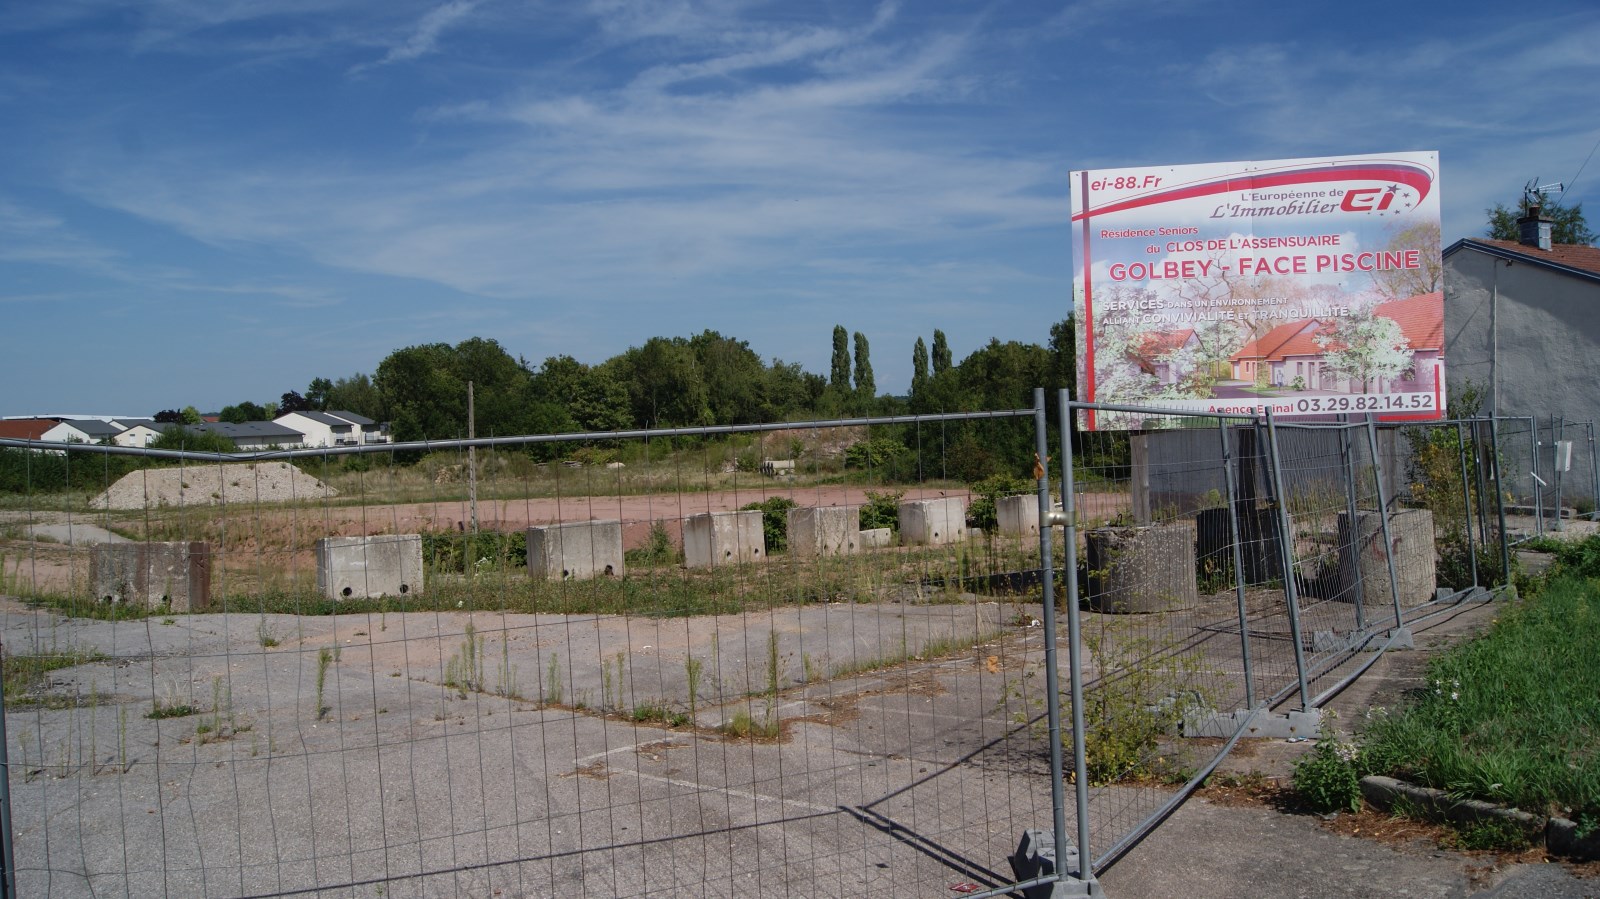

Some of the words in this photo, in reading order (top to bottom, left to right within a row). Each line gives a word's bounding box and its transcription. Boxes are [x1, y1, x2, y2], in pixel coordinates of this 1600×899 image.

[1091, 175, 1162, 191] ei-88.Fr
[1241, 190, 1326, 202] L'Européenne
[1329, 188, 1344, 198] de
[1209, 199, 1341, 219] L'Immobilier
[1101, 228, 1156, 239] Résidence
[1158, 226, 1198, 236] Seniors
[1147, 244, 1160, 254] du
[1166, 240, 1204, 253] CLOS
[1207, 239, 1227, 250] DE
[1230, 235, 1340, 250] L'ASSENSUAIRE
[1109, 259, 1212, 281] GOLBEY
[1239, 255, 1307, 275] FACE
[1316, 250, 1420, 273] PISCINE
[1102, 299, 1164, 311] SERVICES
[1167, 300, 1193, 309] DANS
[1194, 300, 1208, 308] UN
[1209, 297, 1288, 307] ENVIRONNEMENT
[1102, 316, 1140, 325] ALLIANT
[1142, 307, 1234, 324] CONVIVIALITÉ
[1238, 312, 1249, 321] ET
[1252, 304, 1348, 321] TRANQUILLITÉ
[1257, 403, 1294, 414] Einal
[1297, 394, 1432, 412] 03.29.82.14.52
